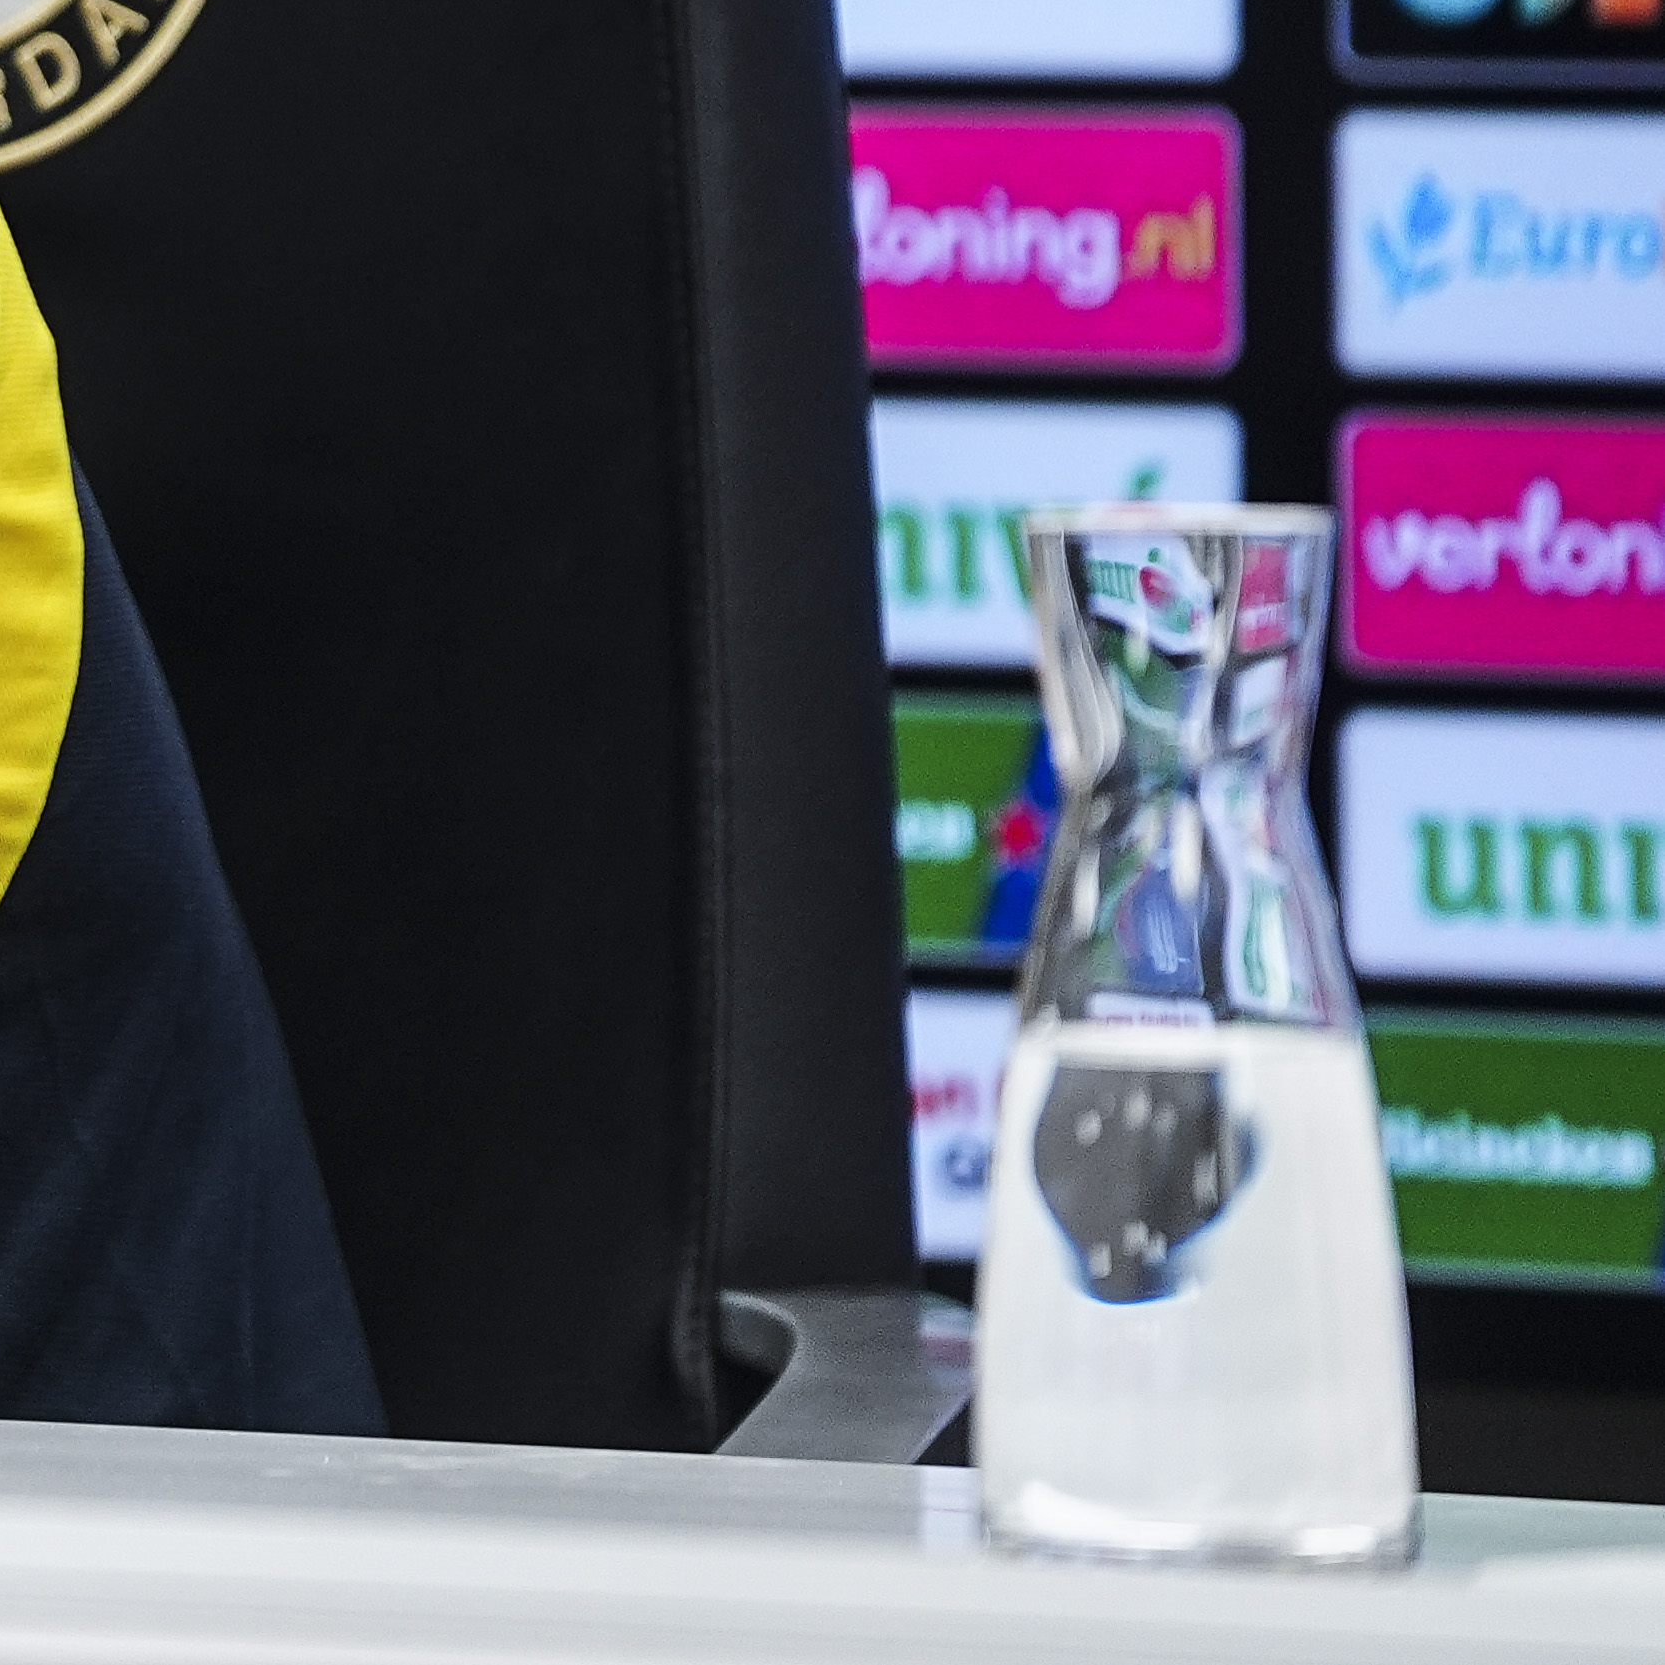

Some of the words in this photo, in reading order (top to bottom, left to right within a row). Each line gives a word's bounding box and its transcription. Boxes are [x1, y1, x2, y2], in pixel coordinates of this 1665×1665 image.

[853, 164, 1216, 310] loning.nl
[1469, 188, 1665, 278] Euro
[1361, 472, 1665, 598] verlon
